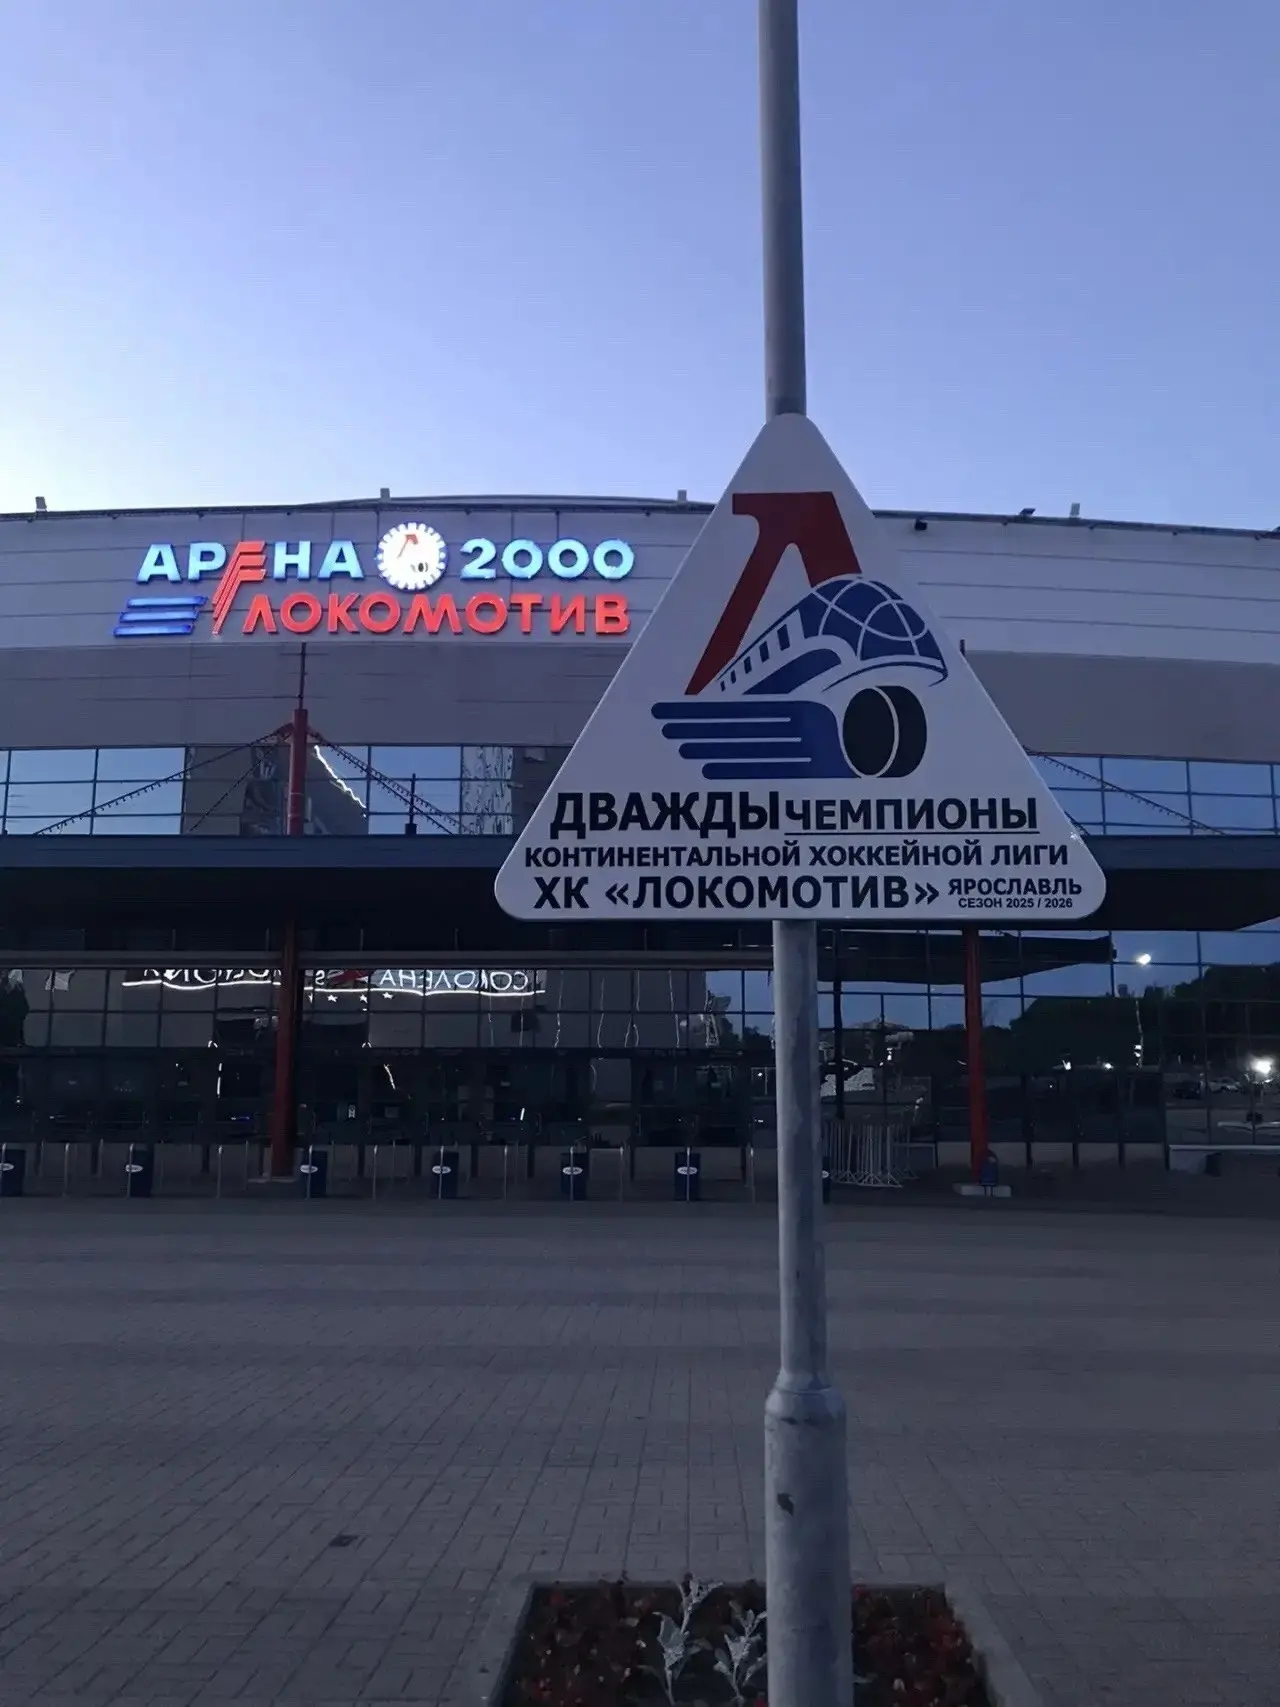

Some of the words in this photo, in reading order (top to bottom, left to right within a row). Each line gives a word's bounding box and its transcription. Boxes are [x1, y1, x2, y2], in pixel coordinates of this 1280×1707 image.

[137, 540, 364, 604] АРЕНА
[460, 538, 635, 580] 2000
[242, 592, 631, 634] ЛОКОМОТИВ
[550, 791, 779, 839] ДВАЖДЫ
[785, 798, 1037, 830] ЧЕМПИОНЫ
[525, 840, 800, 867] КОНТИНЕНТАЛЬНОЙ
[808, 839, 982, 866] ХОККЕЙНОЙ
[990, 845, 1068, 866] ЛИГИ
[533, 876, 589, 909] ХК
[605, 875, 939, 909] «ЛОКОМОТИВ»
[948, 878, 1082, 895] ЯРОСЛАВЛЬ
[958, 898, 1002, 908] СЕЗОН
[1006, 898, 1034, 908] 2025
[1044, 898, 1073, 908] 2026
